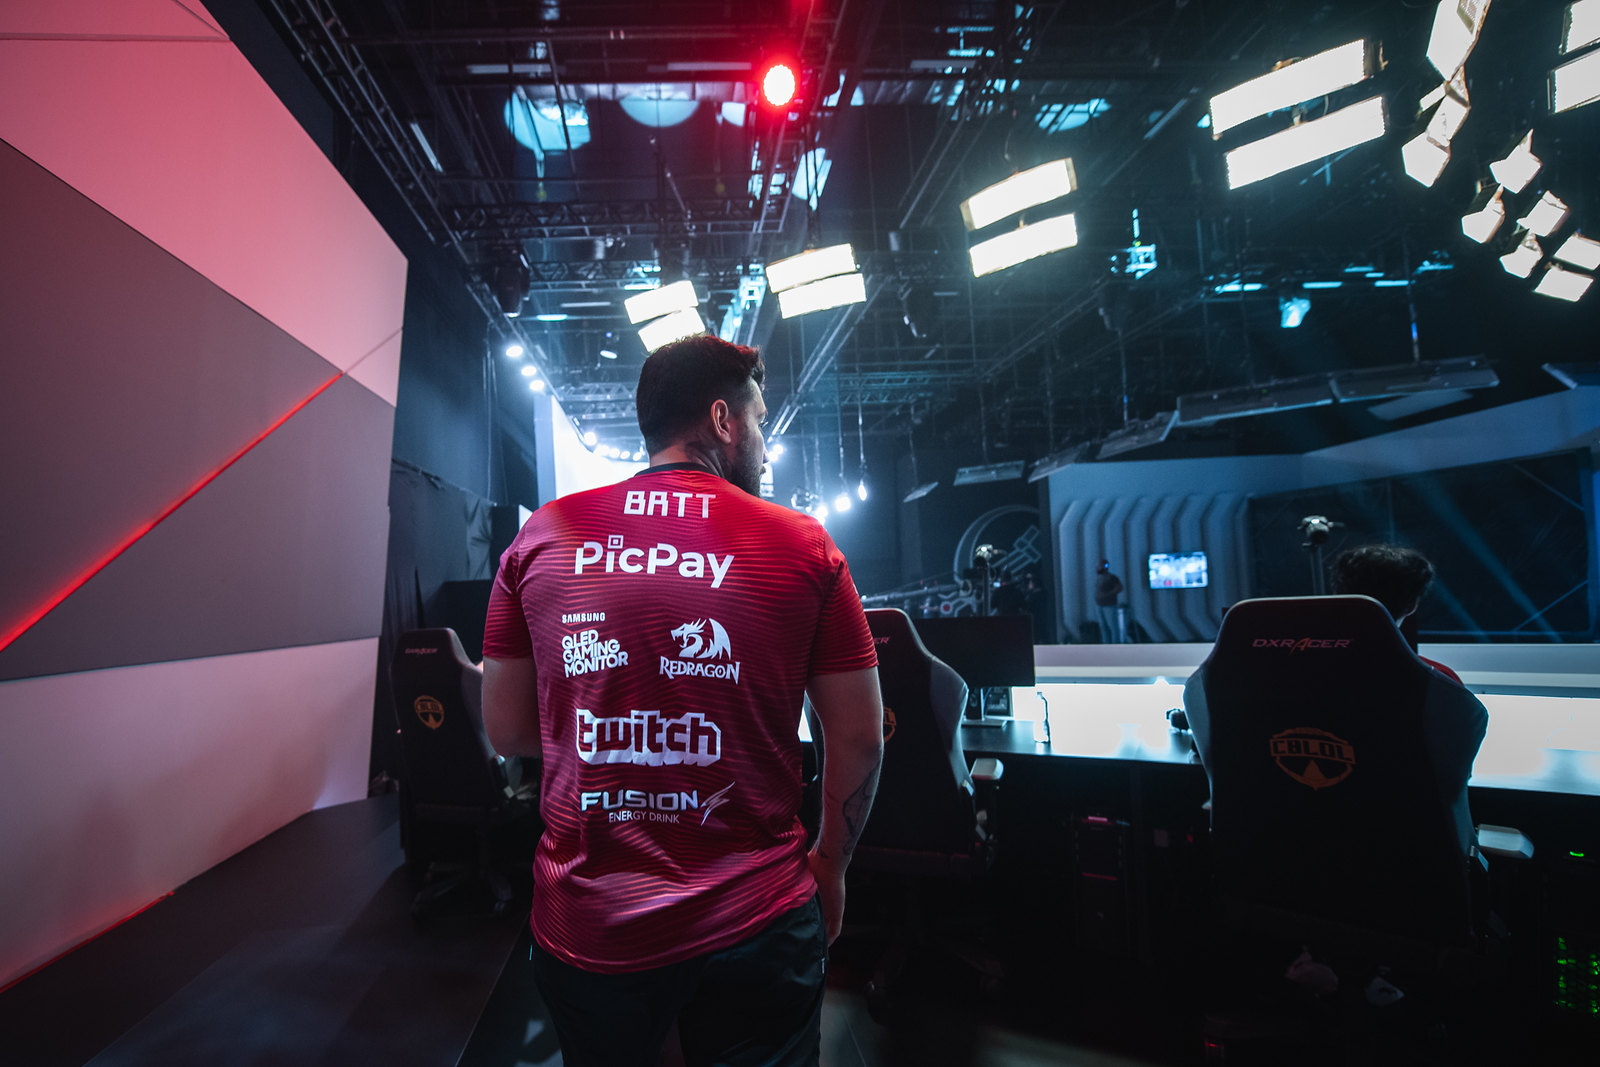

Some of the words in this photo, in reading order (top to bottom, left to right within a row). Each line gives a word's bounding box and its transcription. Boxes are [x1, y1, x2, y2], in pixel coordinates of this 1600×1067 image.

[574, 534, 735, 589] PicPay
[561, 612, 606, 624] SAMSUNG
[561, 629, 599, 650] QLED
[562, 638, 621, 664] GAMING
[1252, 637, 1351, 655] DXRACER
[564, 651, 629, 679] MONITOR
[659, 655, 741, 686] REDRAGON
[576, 708, 722, 767] twitch
[1271, 739, 1354, 764] CBLOL
[580, 789, 699, 812] FUSION
[608, 810, 647, 823] ENERGY
[649, 811, 680, 824] DRINK
